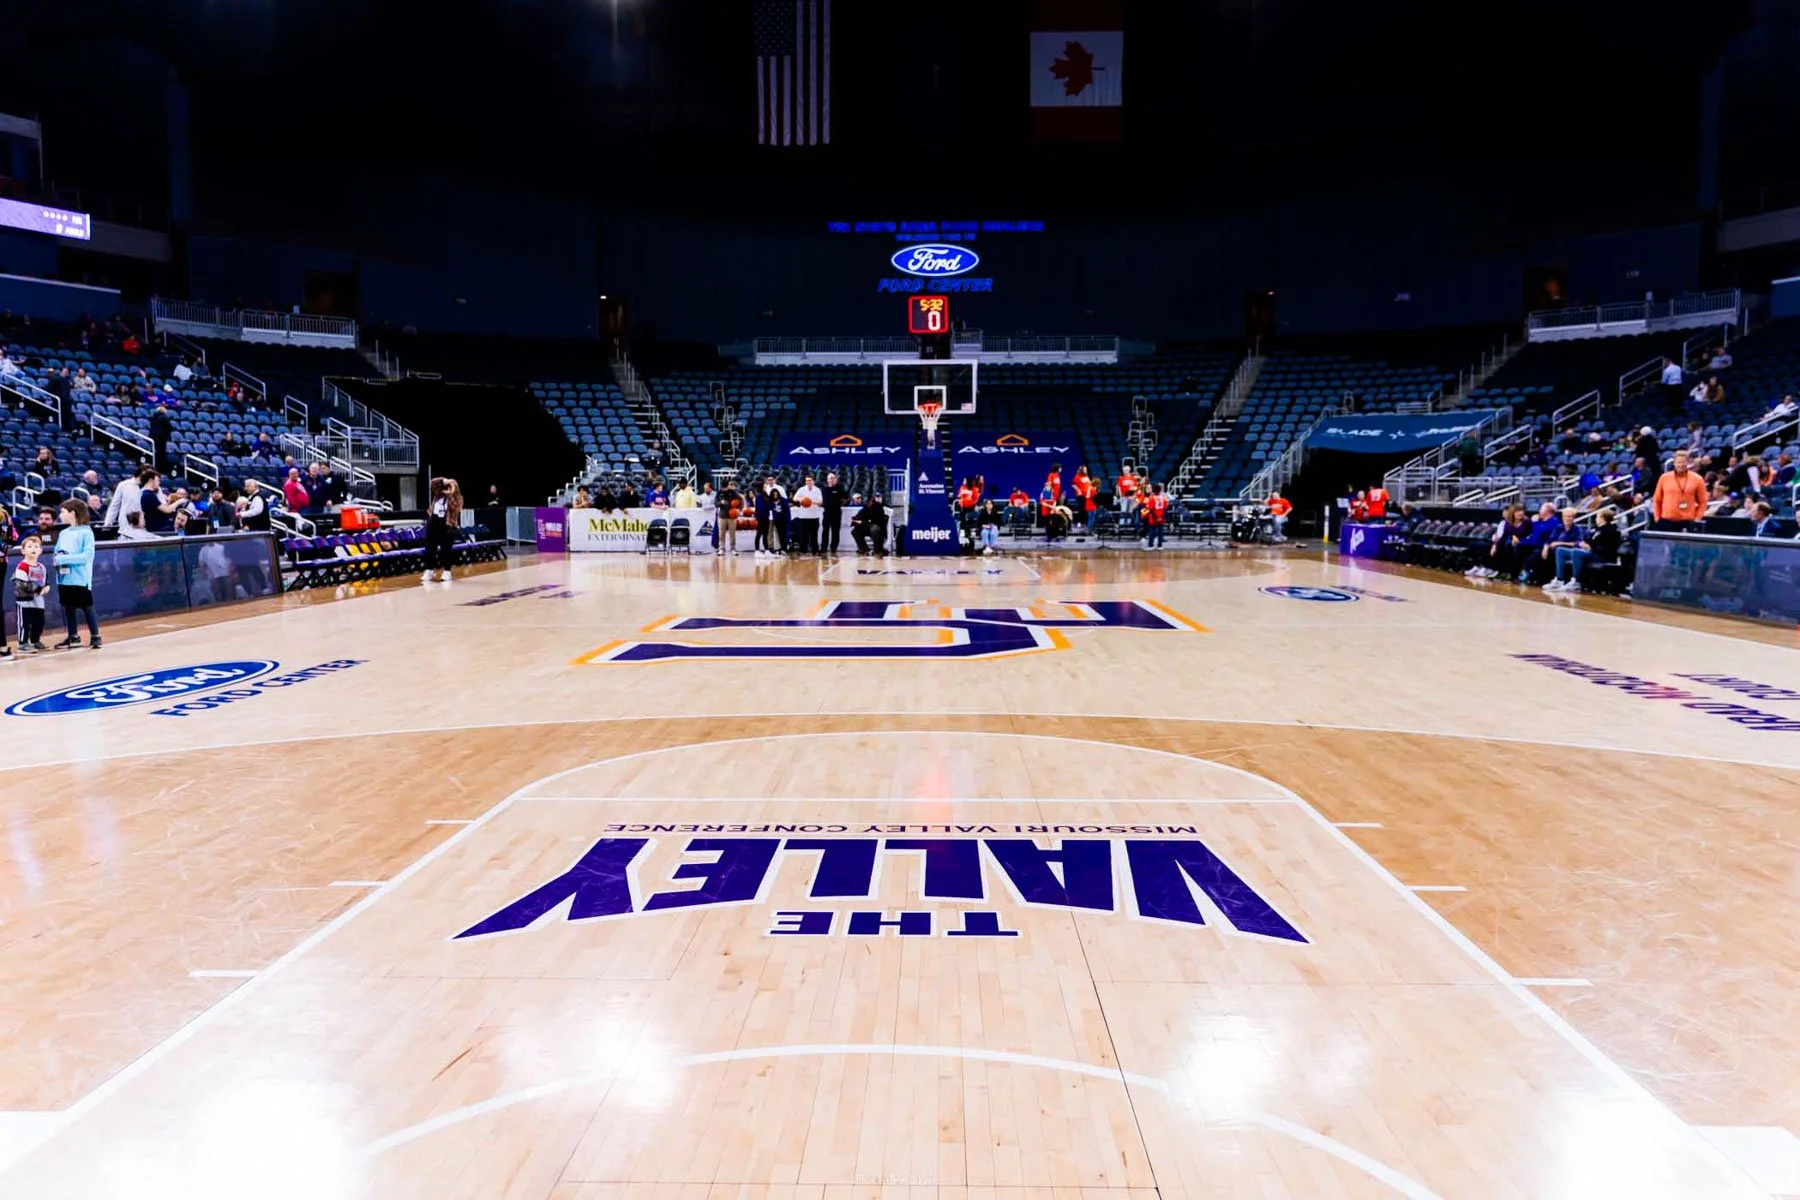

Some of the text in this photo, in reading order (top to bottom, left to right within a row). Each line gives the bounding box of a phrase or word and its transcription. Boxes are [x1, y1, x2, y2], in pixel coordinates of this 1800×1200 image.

[908, 248, 962, 271] Ford
[878, 278, 993, 292] FORD CENTER
[928, 310, 940, 330] 0
[789, 446, 901, 455] ASHLEY
[958, 446, 1070, 454] ASHLEY
[912, 526, 951, 543] meijer
[65, 666, 246, 702] Ford
[148, 658, 370, 717] FORD CENTER
[602, 823, 1198, 834] MISSOURI VALLEY CONFERENCE
[452, 837, 1312, 944] VALLEY
[770, 911, 1018, 936] THE
